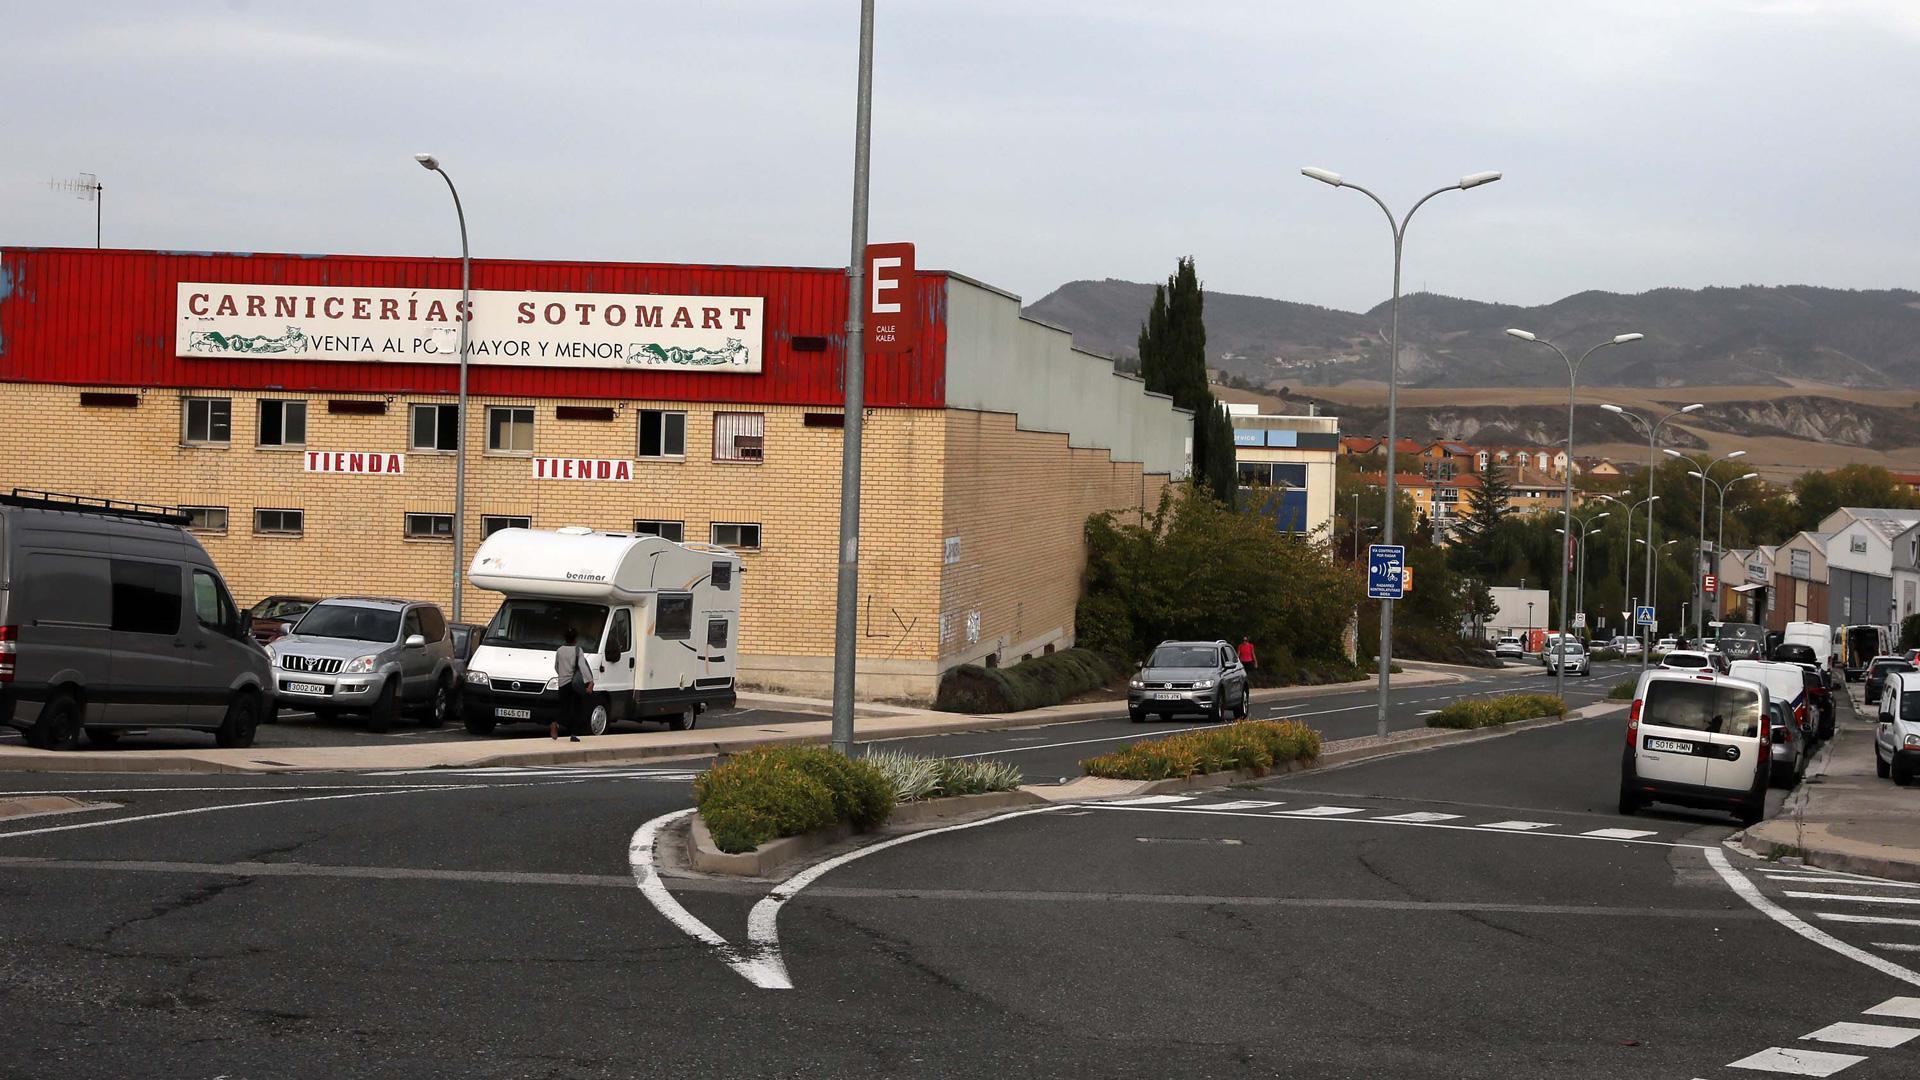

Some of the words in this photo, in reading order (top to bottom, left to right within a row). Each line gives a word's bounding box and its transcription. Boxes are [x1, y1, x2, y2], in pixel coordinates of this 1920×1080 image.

[872, 257, 901, 313] E
[188, 291, 474, 323] CARNICERÍAS
[517, 302, 751, 329] SOTOMART
[876, 325, 896, 333] CALLE
[875, 334, 896, 342] KALEA
[311, 335, 374, 353] VENTA
[382, 337, 405, 354] AL
[538, 342, 550, 358] Y
[555, 342, 623, 360] MENOR
[308, 451, 401, 473] TIENDA
[536, 458, 630, 480] TIENDA
[566, 571, 606, 581] benimar
[1705, 576, 1715, 587] E
[291, 683, 309, 692] 3002
[1655, 740, 1674, 750] 5016
[1676, 743, 1691, 752] HMN
